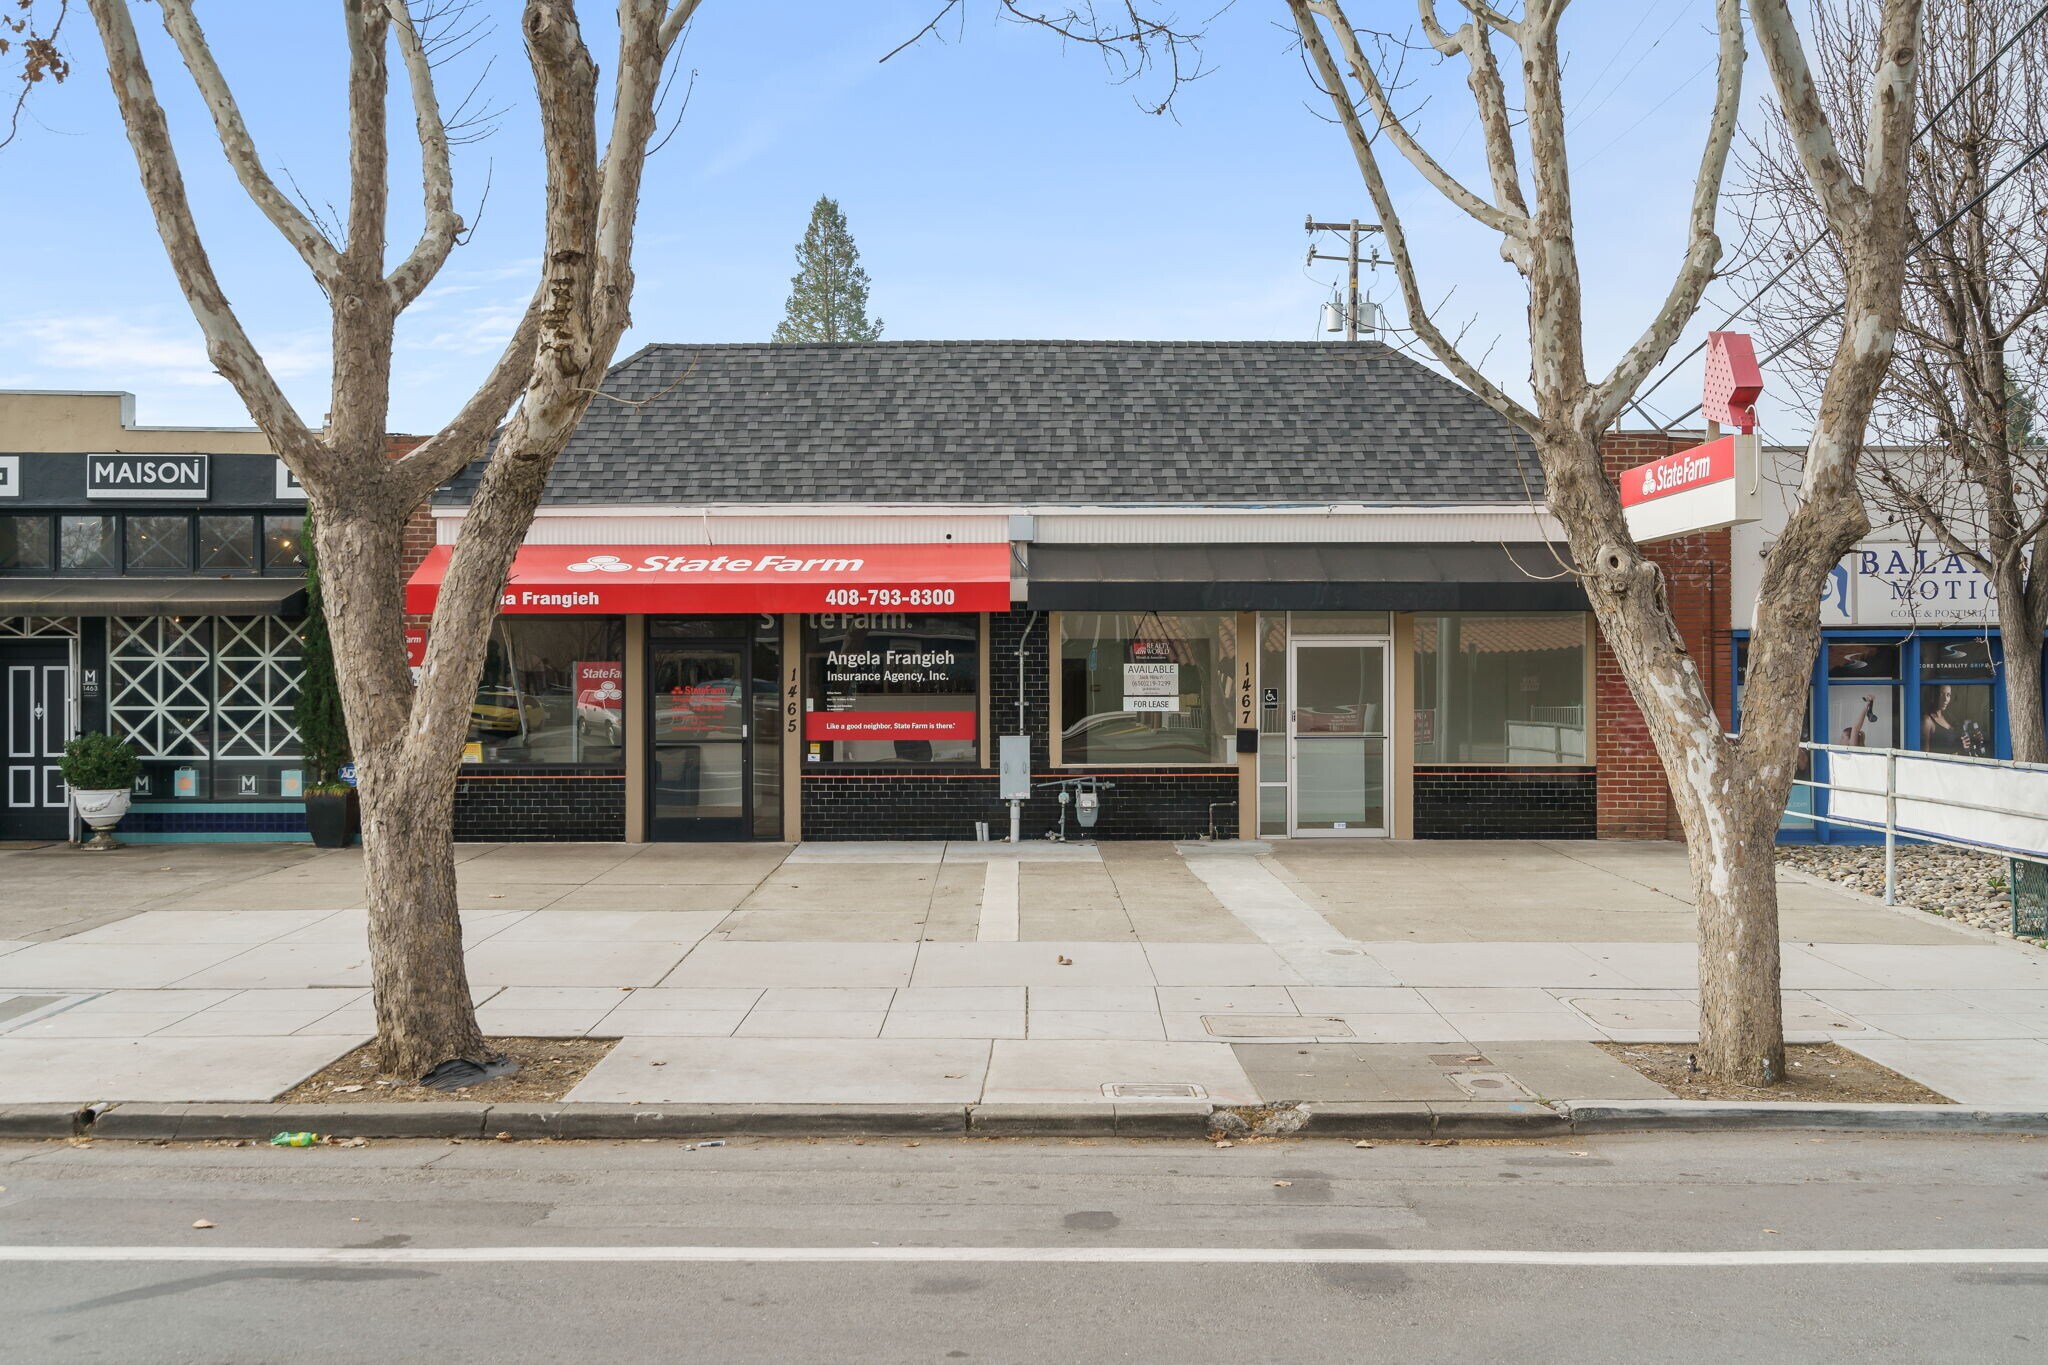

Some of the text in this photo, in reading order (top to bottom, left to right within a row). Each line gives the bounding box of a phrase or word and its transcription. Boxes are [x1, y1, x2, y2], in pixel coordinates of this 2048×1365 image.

[824, 589, 955, 606] 408-793-8300
[1890, 580, 1999, 600] MOTIO
[522, 592, 599, 608] Frangieh
[1890, 609, 1922, 618] CORE
[1924, 609, 1933, 618] &
[826, 650, 955, 668] Angela Frangieh
[827, 670, 949, 682] Insurance Agency, Inc.
[1127, 665, 1175, 674] AVAILABLE
[787, 668, 798, 733] 1465
[1241, 662, 1251, 724] 1467
[846, 723, 862, 731] good
[894, 722, 911, 730] State
